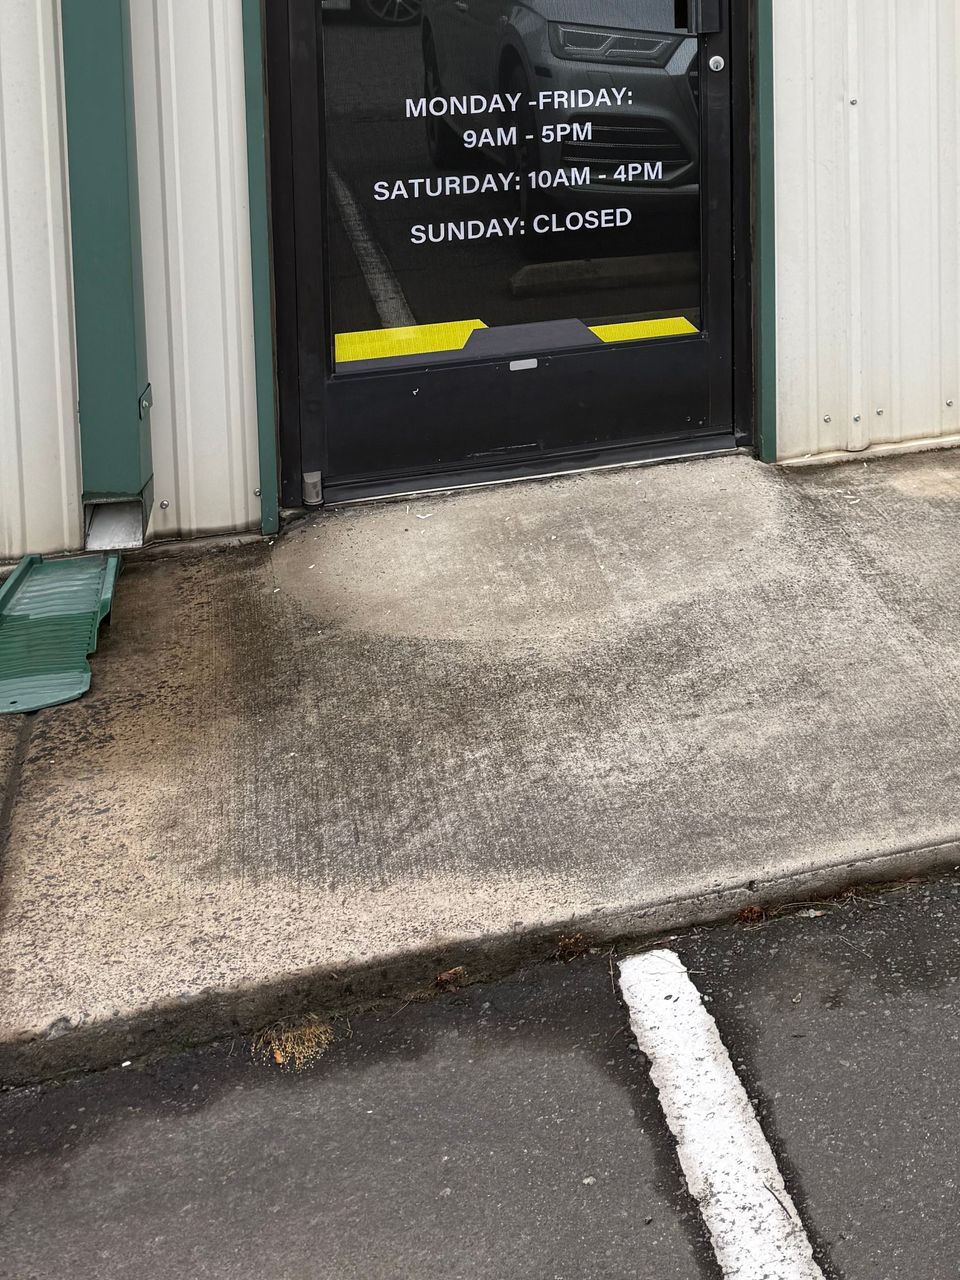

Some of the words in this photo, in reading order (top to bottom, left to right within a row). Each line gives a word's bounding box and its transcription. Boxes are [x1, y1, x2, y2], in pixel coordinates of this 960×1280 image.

[405, 92, 522, 118] MONDAY
[463, 126, 517, 148] 9AM
[541, 121, 592, 143] 5PM
[373, 172, 521, 201] SATURDAY:
[528, 166, 590, 189] 10AM
[613, 161, 663, 182] 4PM
[410, 216, 525, 244] SUNDAY:
[533, 208, 632, 233] CLOSED
